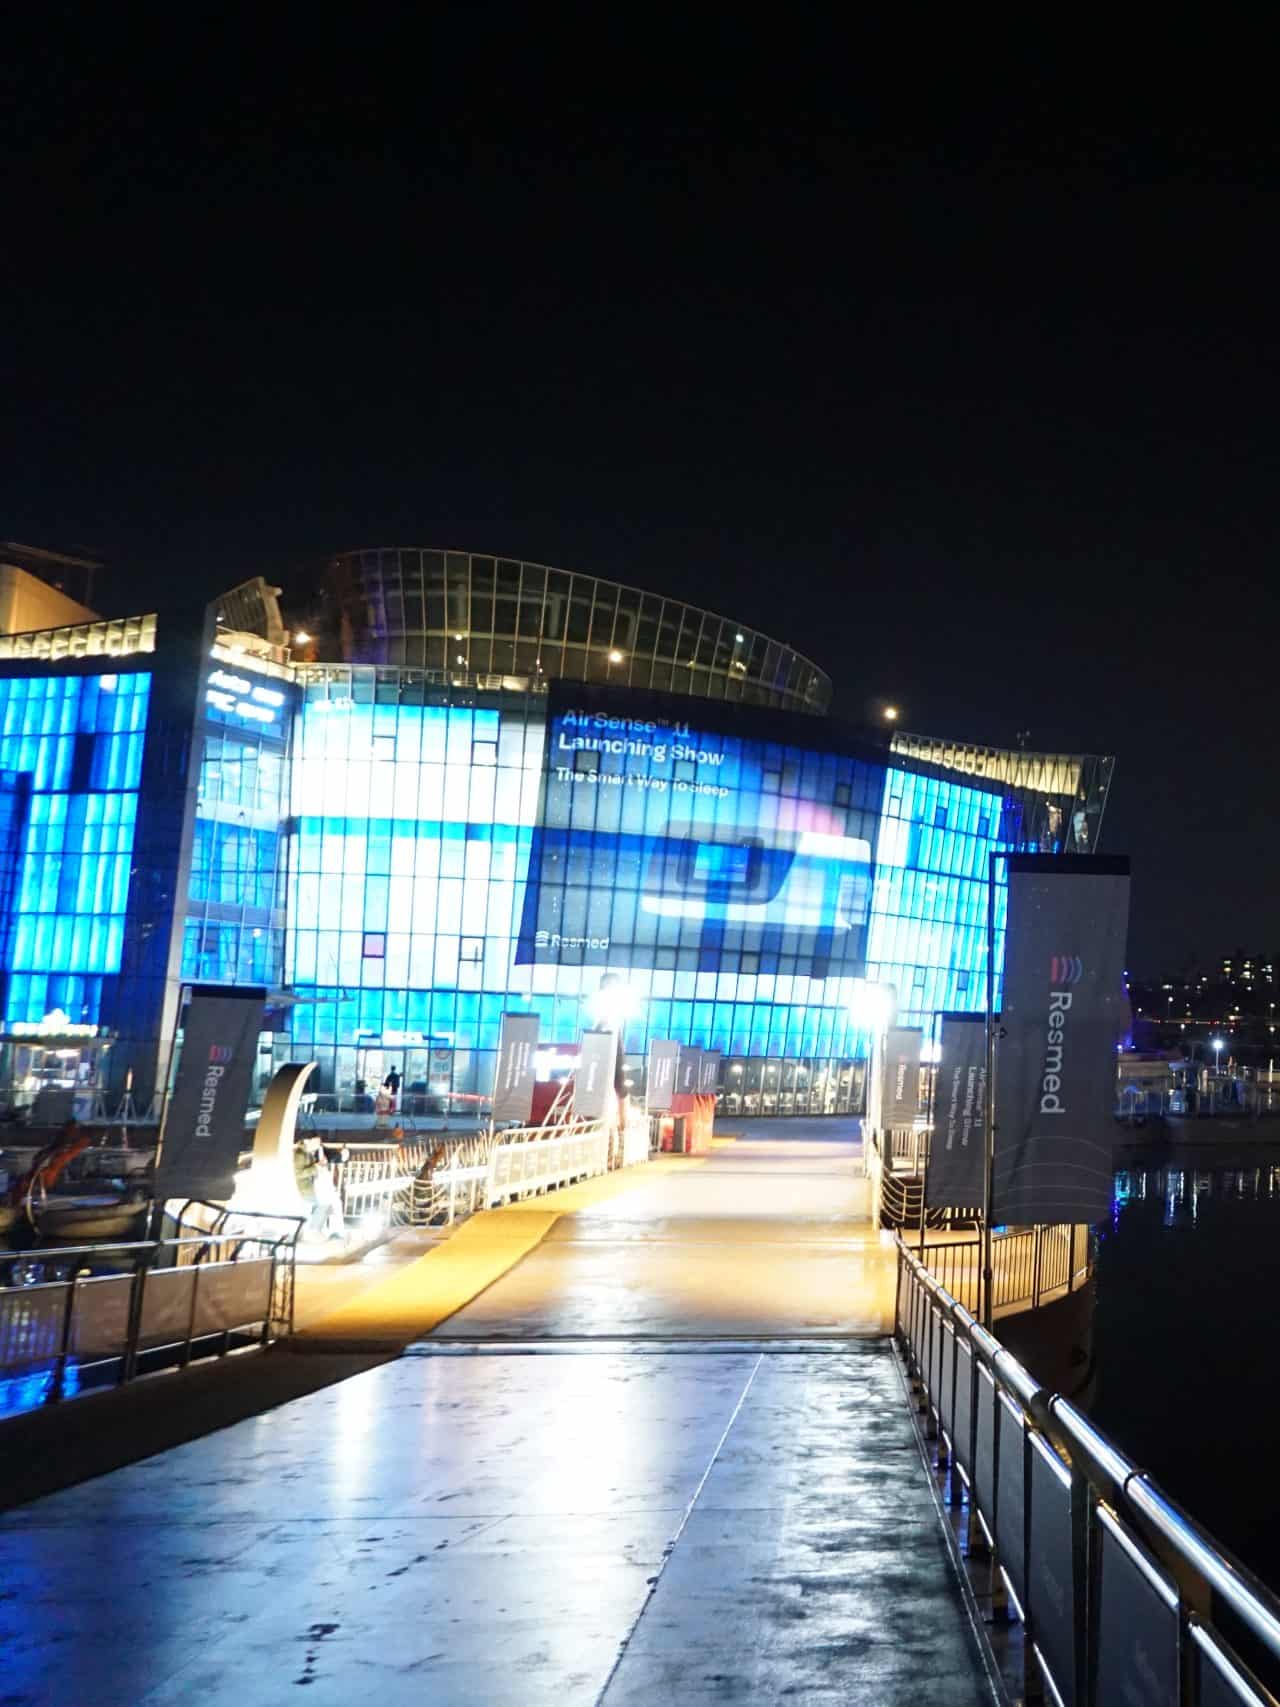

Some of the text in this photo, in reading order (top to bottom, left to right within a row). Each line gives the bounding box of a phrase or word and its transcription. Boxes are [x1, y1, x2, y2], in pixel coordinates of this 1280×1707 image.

[672, 720, 691, 738] 11
[558, 732, 725, 767] Launching Show
[556, 766, 585, 783] The
[635, 772, 669, 793] Way
[551, 934, 610, 950] Resmed
[1040, 991, 1073, 1114] Resmed
[195, 1065, 225, 1137] Resmed
